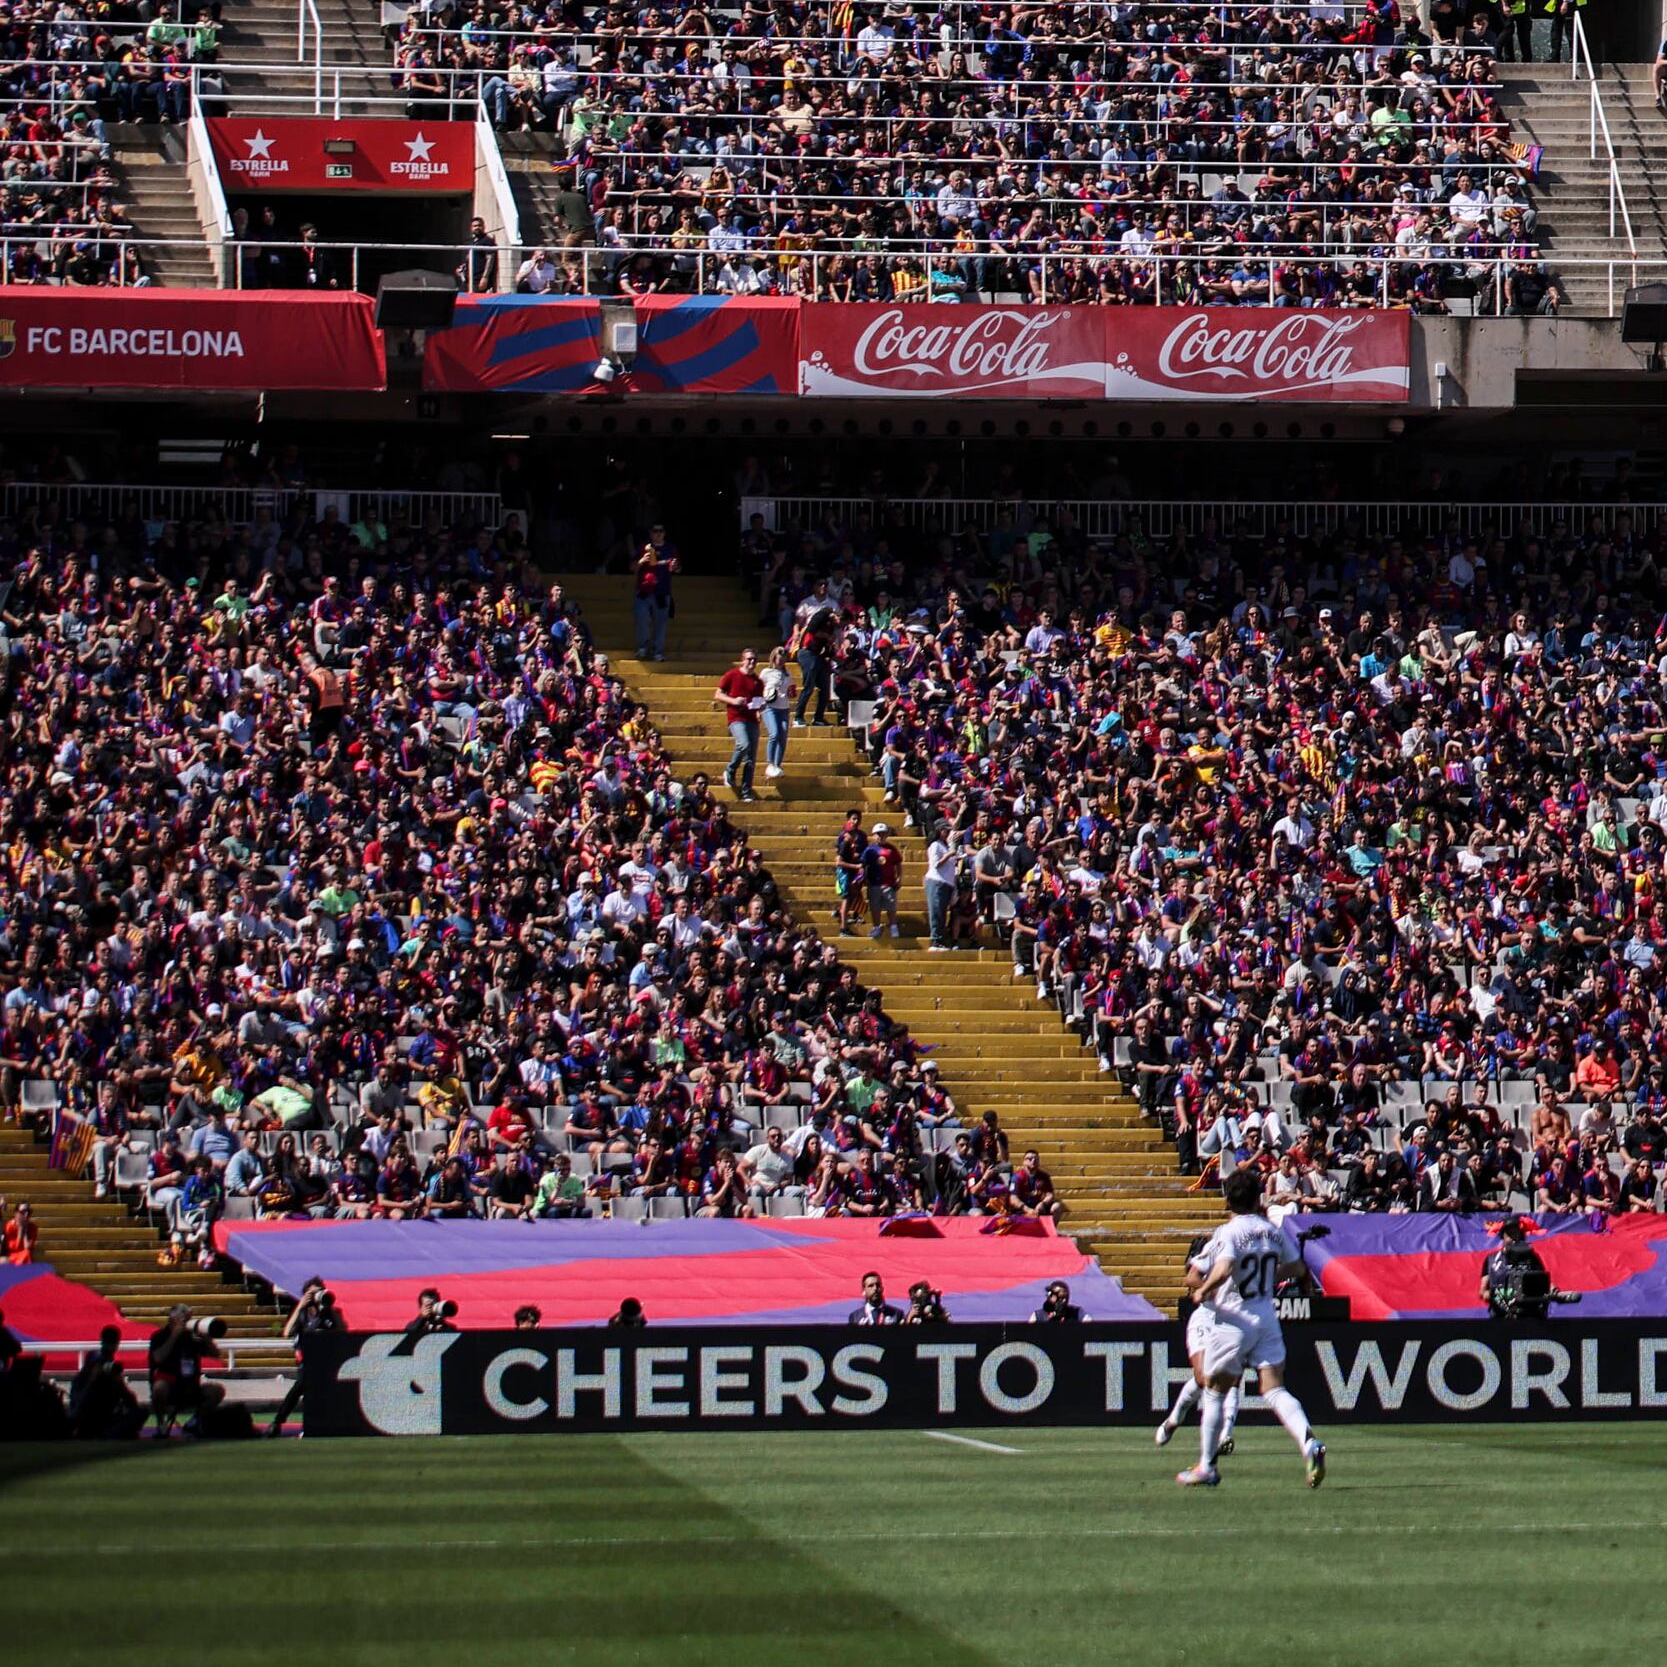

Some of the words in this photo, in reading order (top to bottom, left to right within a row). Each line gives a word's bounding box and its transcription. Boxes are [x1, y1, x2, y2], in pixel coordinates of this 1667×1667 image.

[230, 159, 289, 171] ESTRELLA
[390, 161, 449, 174] ESTRELLA
[27, 327, 62, 354] FC
[70, 328, 245, 357] BARCELONA
[854, 308, 1062, 378] Coca-Cola
[1159, 312, 1367, 381] Coca-Cola
[1239, 1251, 1279, 1300] 20
[483, 1342, 889, 1419] CHEERS
[916, 1341, 1055, 1414] TO
